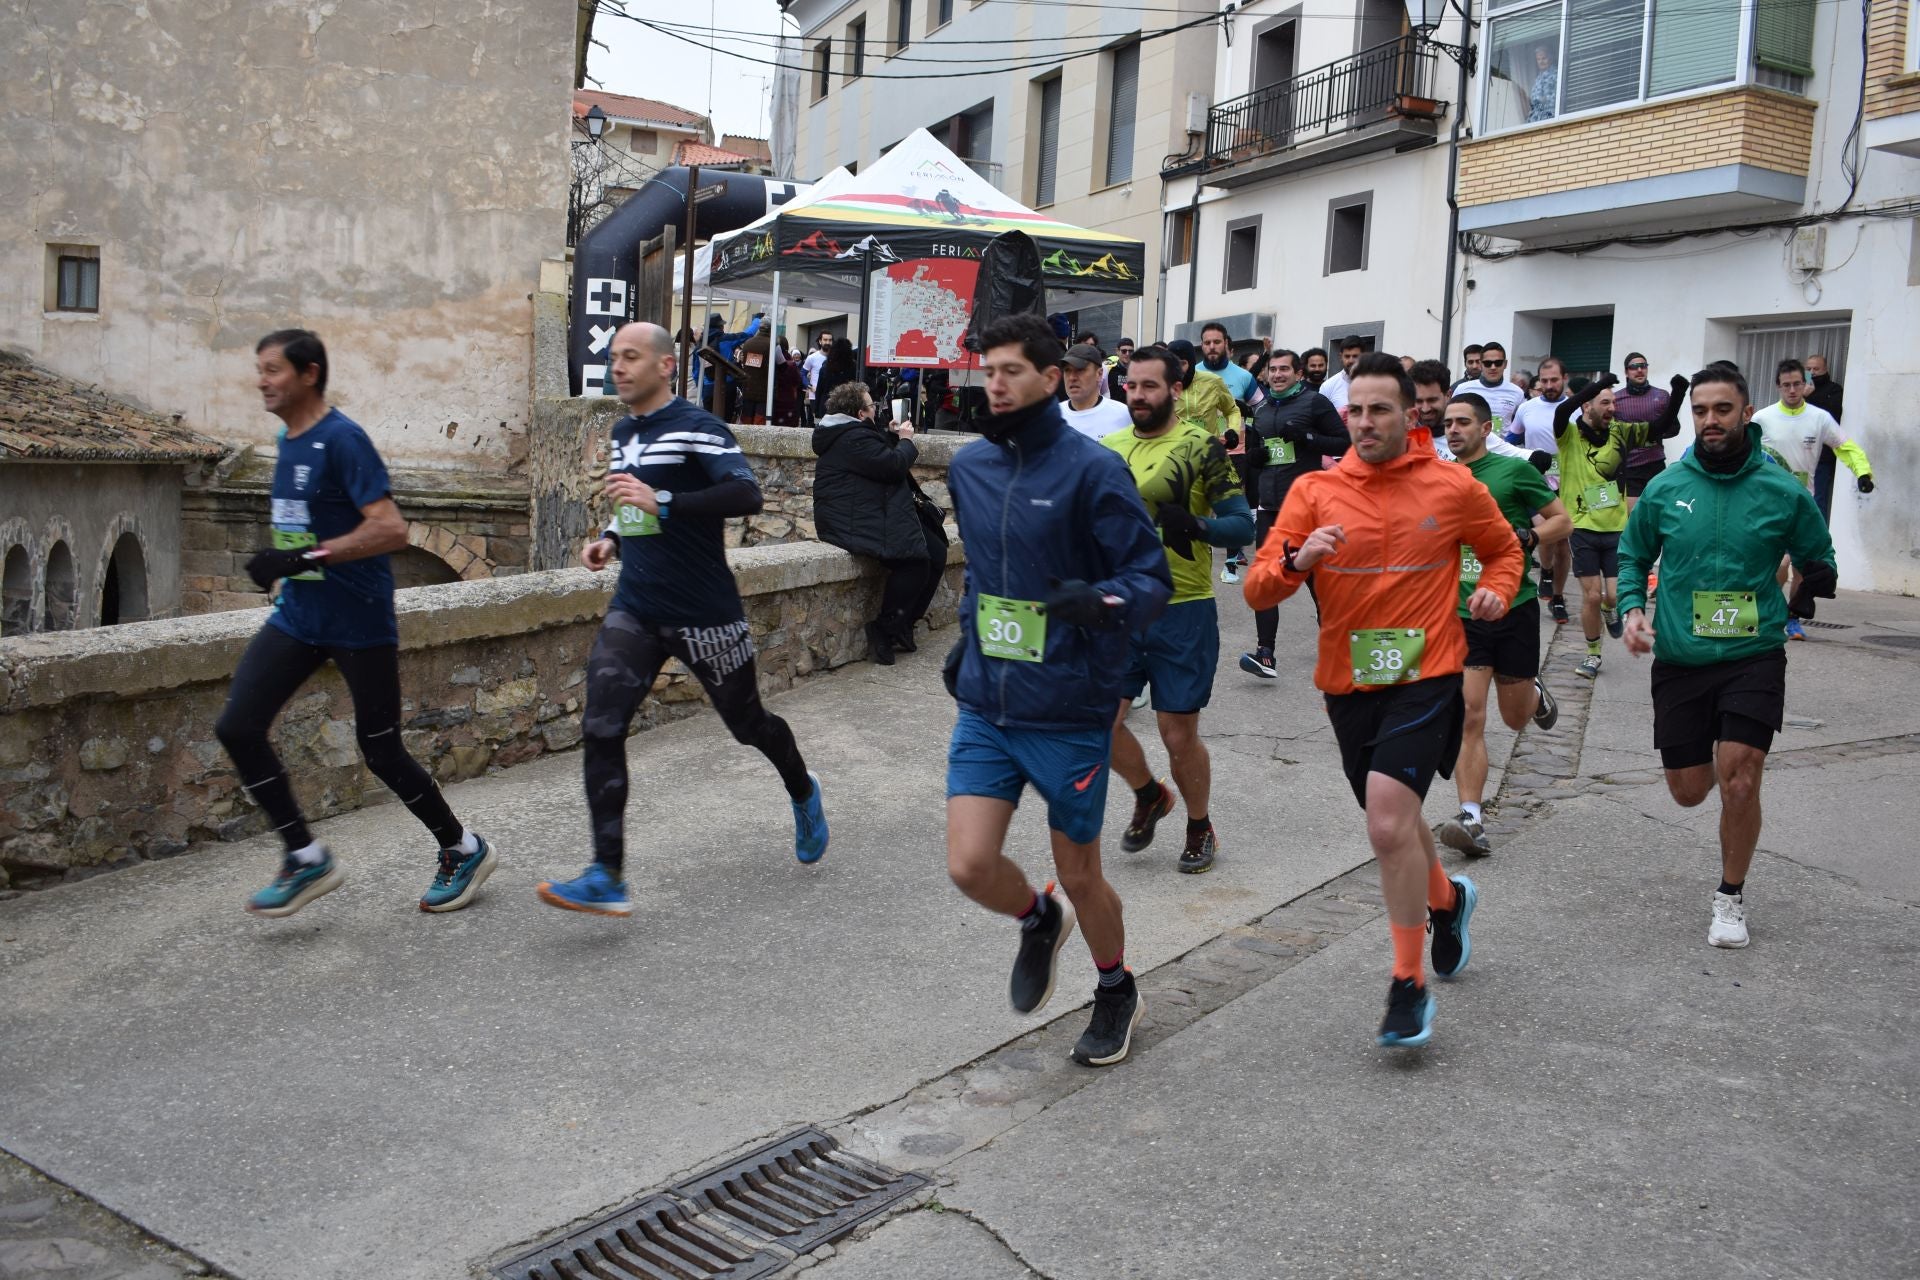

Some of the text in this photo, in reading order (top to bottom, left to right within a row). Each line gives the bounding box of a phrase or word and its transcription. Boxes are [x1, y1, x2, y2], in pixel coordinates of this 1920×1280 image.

[1270, 447, 1284, 458] 78
[1600, 491, 1608, 502] 5
[1462, 558, 1483, 573] 55
[1711, 608, 1739, 626] 47
[988, 618, 1023, 644] 30
[1370, 648, 1404, 671] 38
